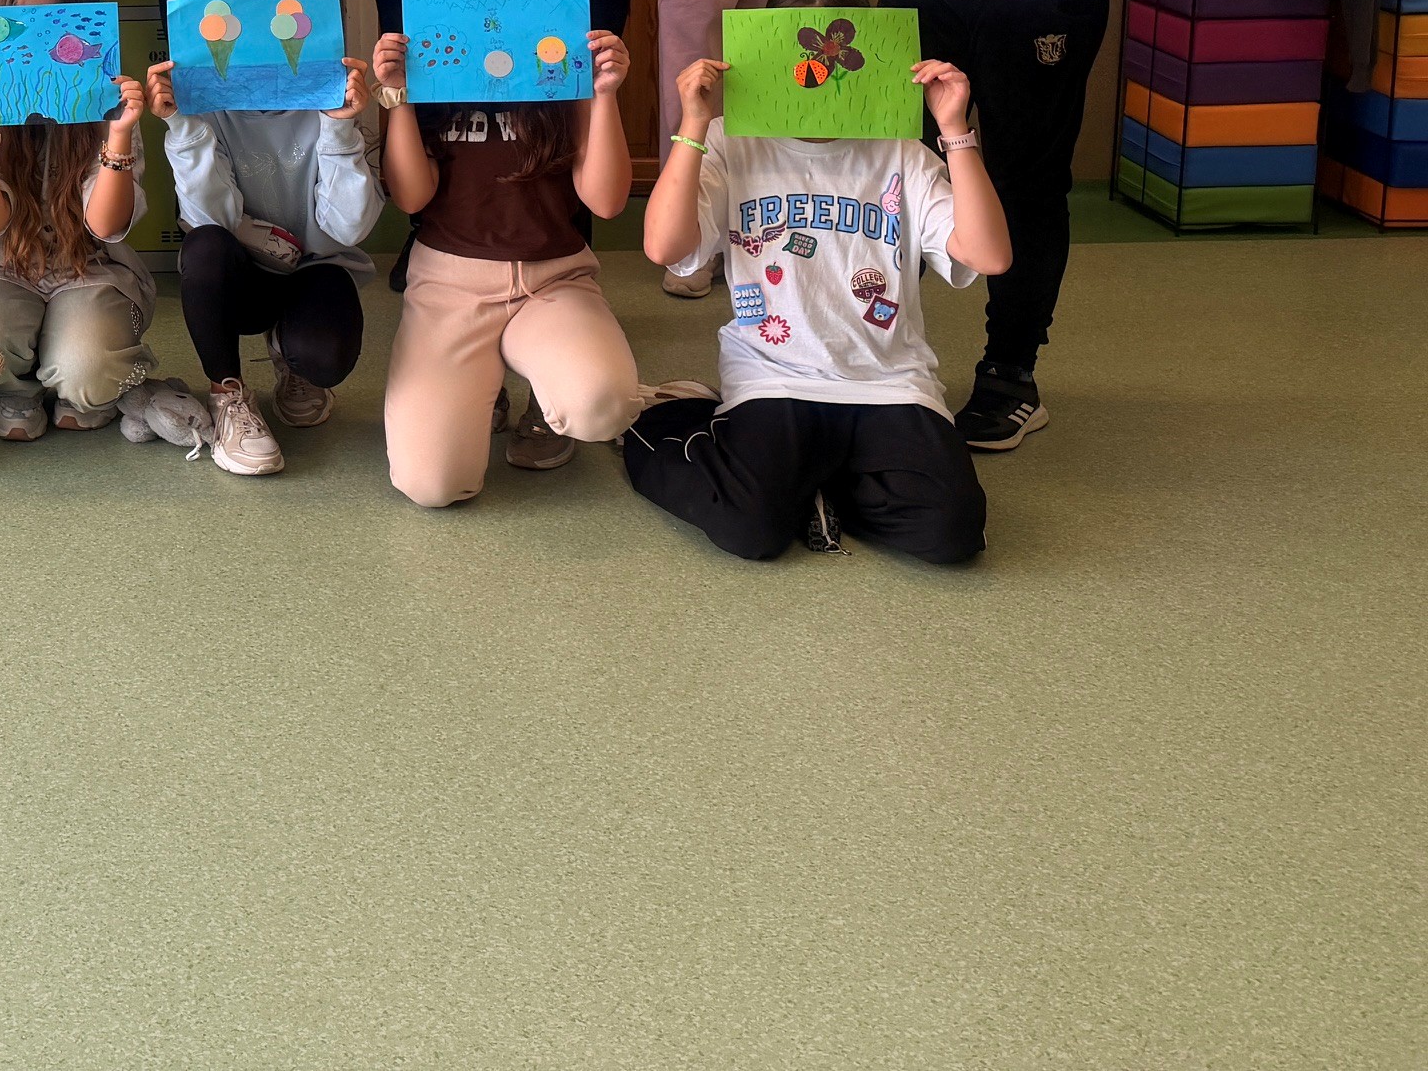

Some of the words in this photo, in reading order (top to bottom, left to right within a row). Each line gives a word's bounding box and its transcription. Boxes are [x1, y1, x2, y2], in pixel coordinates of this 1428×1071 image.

[149, 50, 167, 62] 03
[793, 239, 813, 249] GOOD
[791, 245, 812, 256] DAY
[852, 273, 884, 288] COLLEGE
[734, 287, 761, 299] ONLY
[735, 298, 763, 309] GOOD
[736, 307, 765, 319] VIBES
